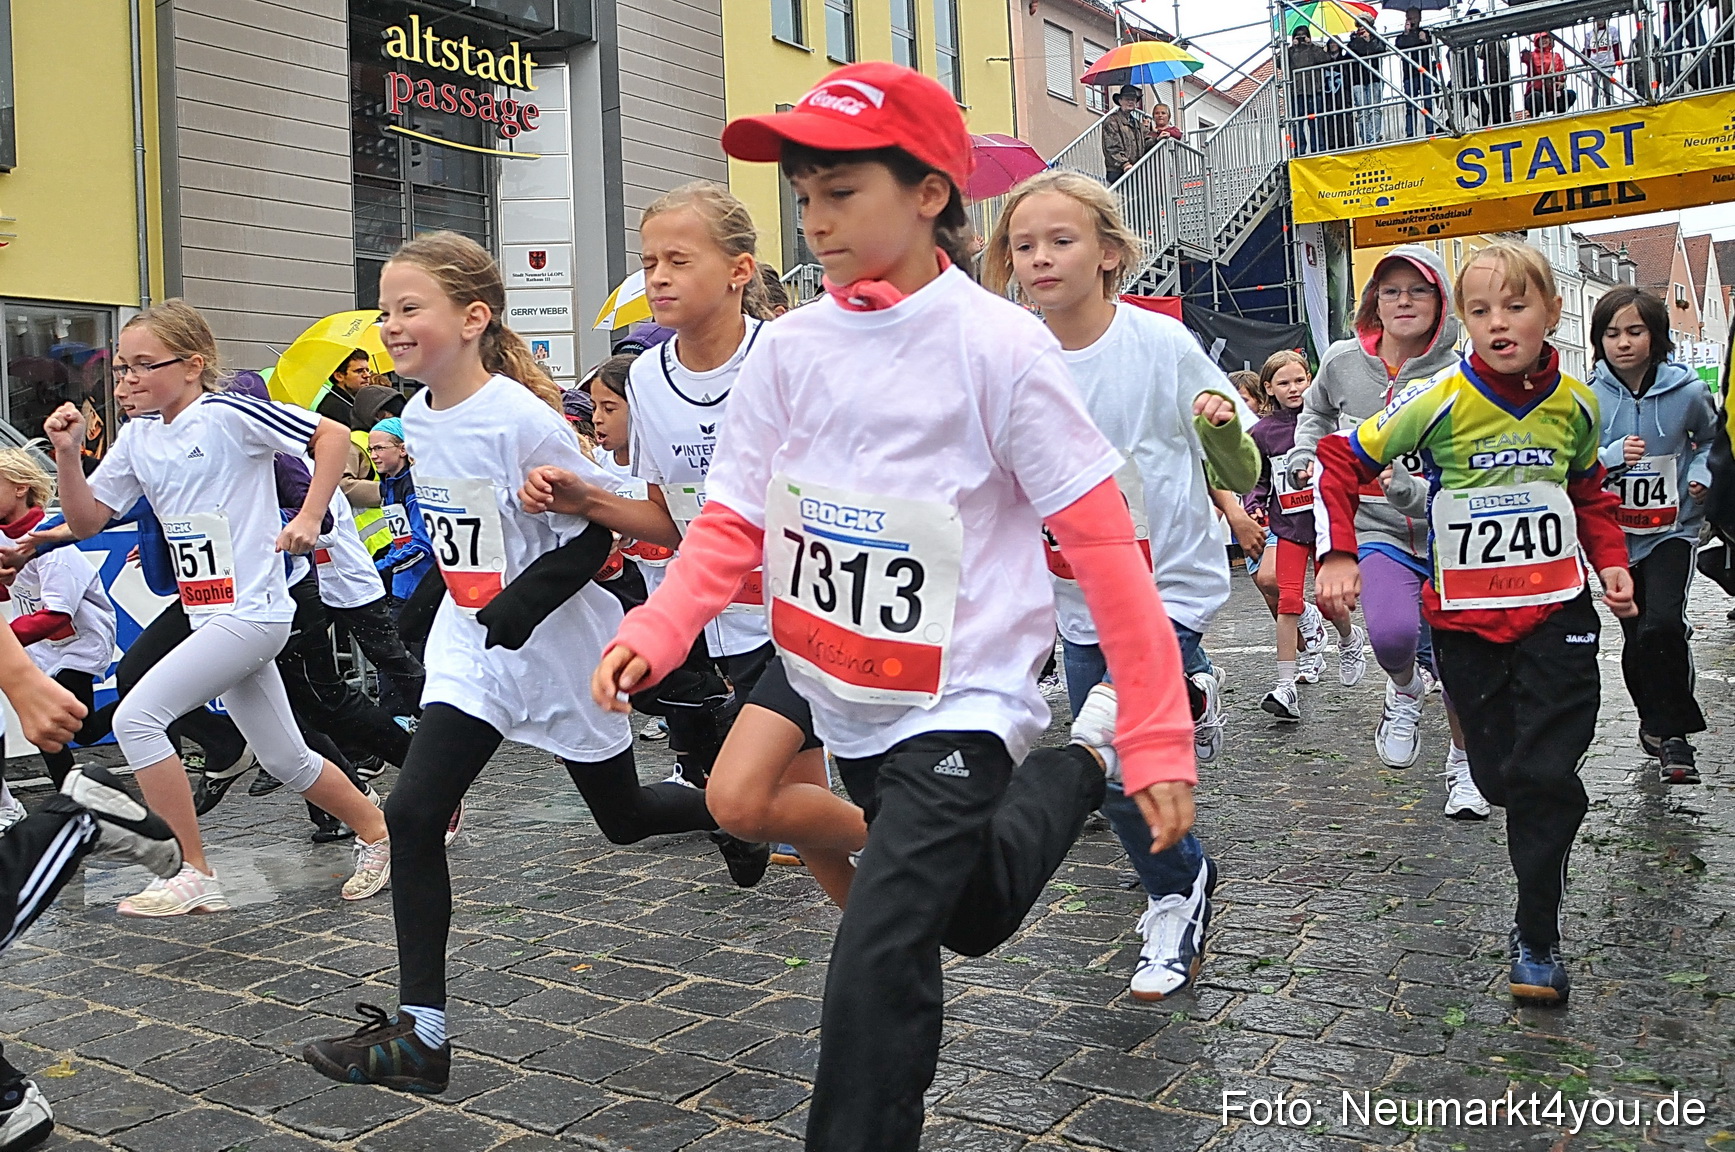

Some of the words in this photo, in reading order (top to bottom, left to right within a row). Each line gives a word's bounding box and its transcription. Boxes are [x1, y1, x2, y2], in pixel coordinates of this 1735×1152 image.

[386, 14, 540, 91] altstadt
[388, 71, 540, 139] passage
[1455, 121, 1645, 190] START
[1317, 185, 1377, 200] Neumarkter
[1378, 176, 1425, 194] Stadtlauf
[1429, 207, 1473, 221] Stadtlauf
[510, 308, 538, 316] GERRY
[539, 307, 568, 315] WEBER
[1471, 431, 1532, 450] TEAM
[1470, 447, 1556, 470] BOCK
[800, 498, 886, 532] BOCK
[1469, 491, 1531, 511] BOCK
[1448, 512, 1562, 565] 7240
[783, 527, 925, 634] 7313
[806, 622, 880, 678] Kristina
[933, 765, 970, 778] adidas
